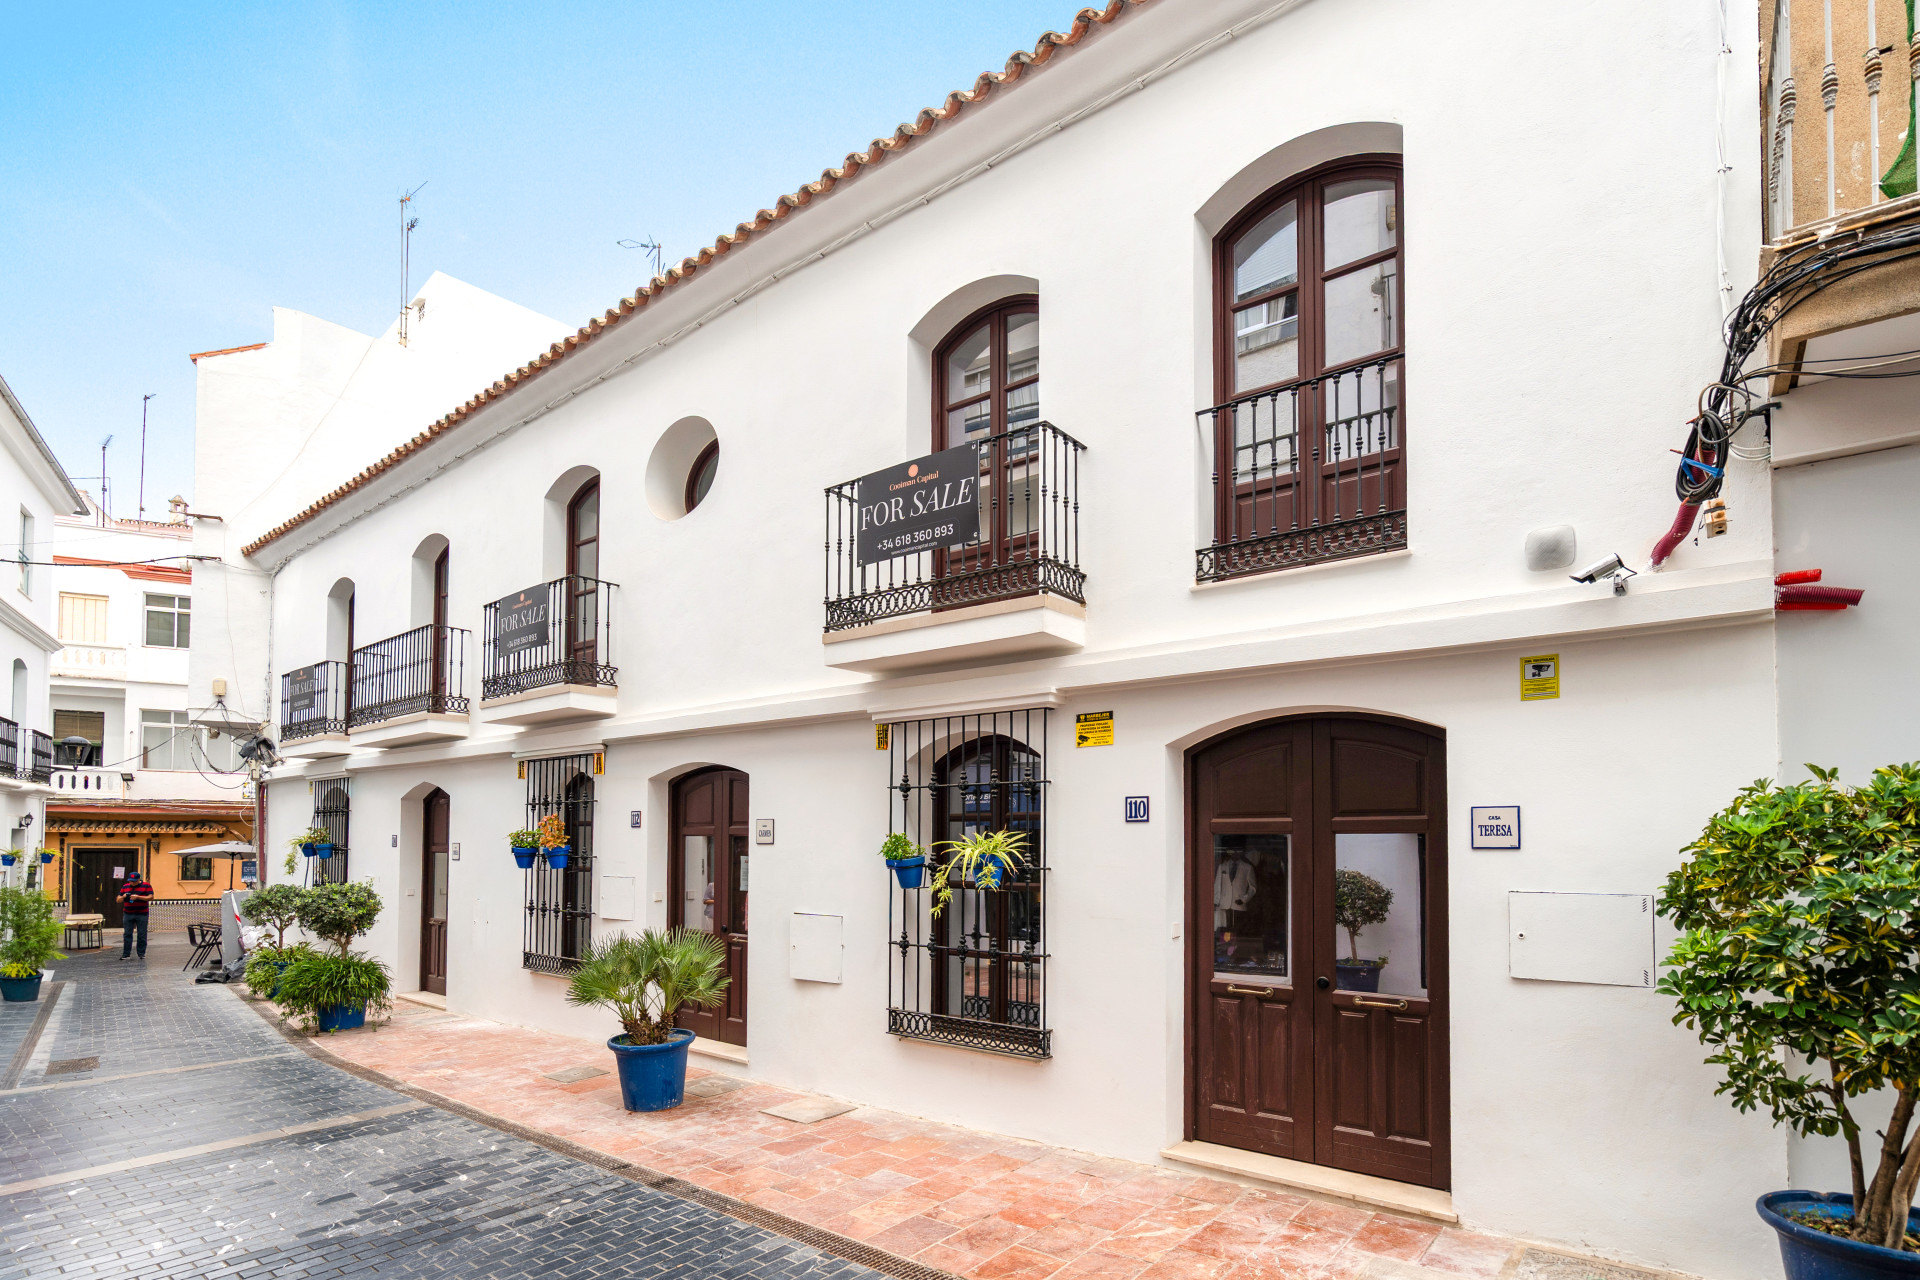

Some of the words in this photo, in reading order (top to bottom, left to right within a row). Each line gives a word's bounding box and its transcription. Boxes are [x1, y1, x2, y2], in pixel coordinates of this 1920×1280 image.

[916, 470, 938, 483] Capital
[861, 497, 906, 531] FOR
[910, 476, 974, 517] SALE
[877, 538, 894, 550] +34
[895, 533, 912, 547] 618
[913, 528, 932, 543] 360
[934, 523, 954, 538] 893
[500, 613, 518, 635] FOR
[519, 604, 546, 627] SALE
[300, 680, 313, 694] SALE
[1128, 799, 1147, 819] 110
[631, 812, 640, 826] 112
[1477, 824, 1513, 837] TERESA
